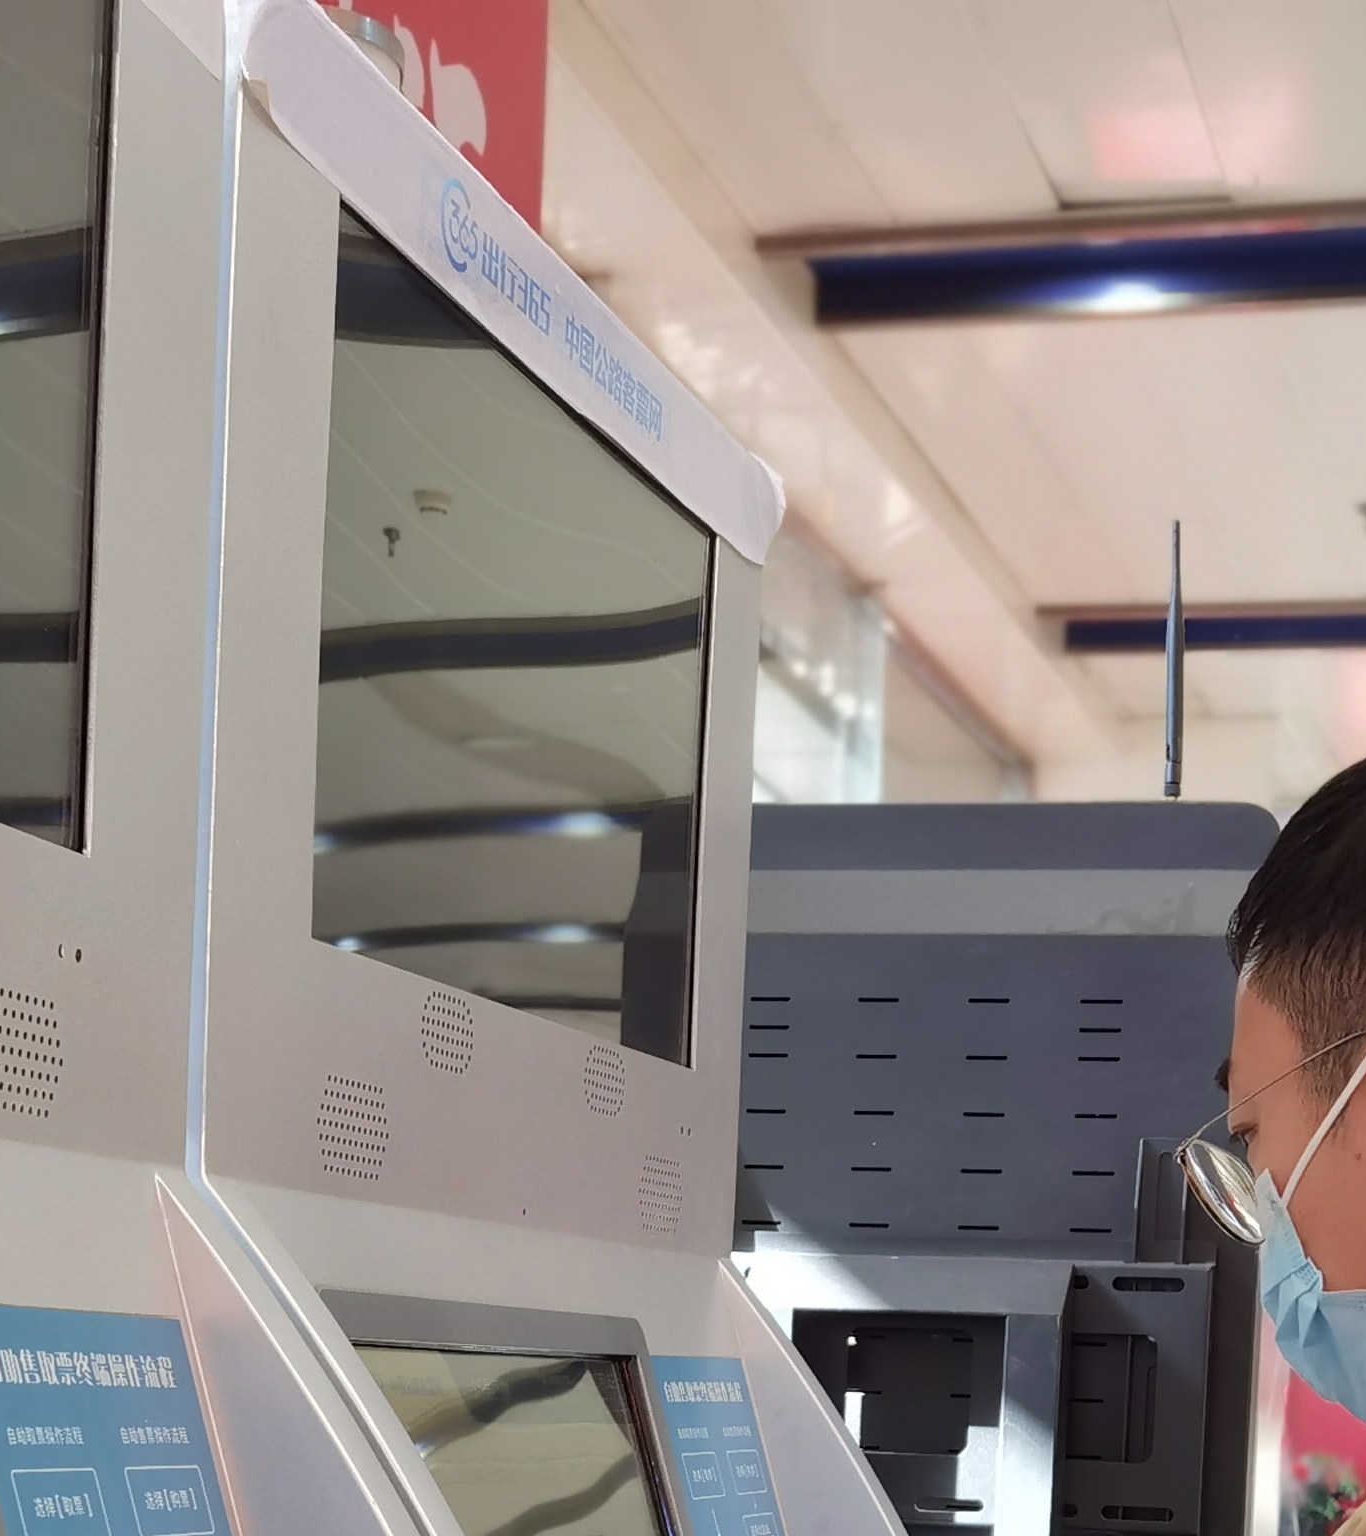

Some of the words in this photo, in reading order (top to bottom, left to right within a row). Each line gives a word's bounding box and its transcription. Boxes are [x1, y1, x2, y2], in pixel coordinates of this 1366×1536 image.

[482, 231, 552, 337] 出行365
[565, 313, 663, 442] 中国公路客票网
